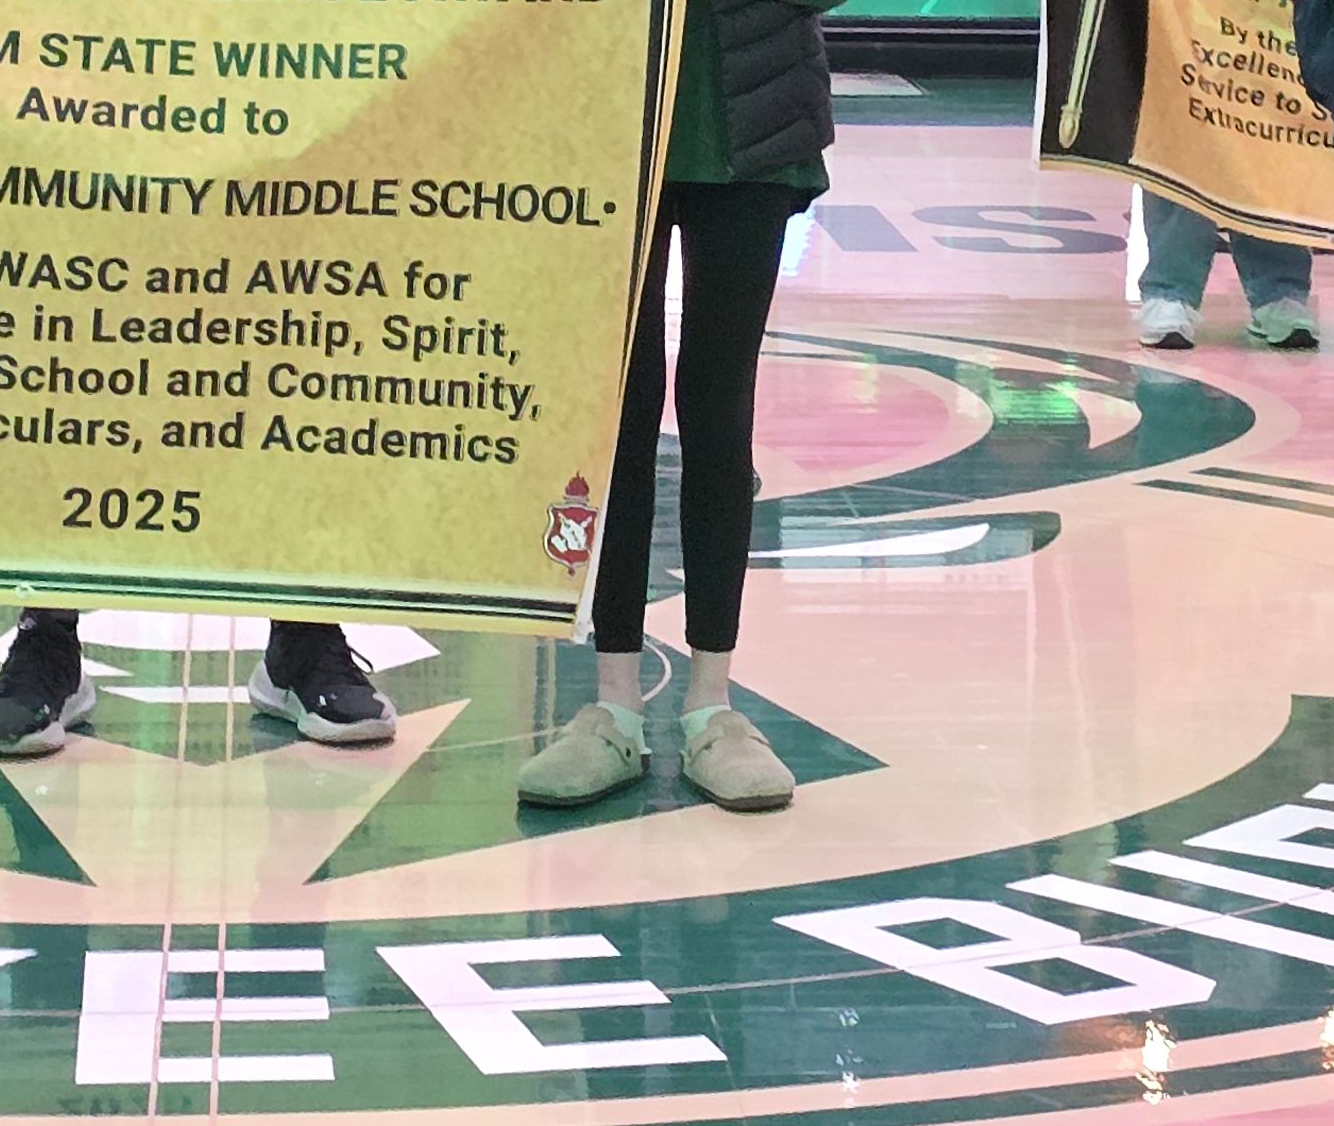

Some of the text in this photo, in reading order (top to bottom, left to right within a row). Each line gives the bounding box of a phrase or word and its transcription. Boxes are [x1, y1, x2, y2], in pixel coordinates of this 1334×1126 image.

[39, 32, 197, 78] STATE
[212, 40, 408, 80] WINNER
[1219, 15, 1298, 57] By the
[16, 86, 289, 136] Awarded to
[1276, 90, 1302, 116] to
[224, 178, 402, 218] MIDDLE
[145, 257, 230, 295] and
[245, 258, 388, 298] AWSA
[404, 260, 472, 301] for
[33, 304, 74, 342] in
[91, 307, 365, 357] Leadership,
[381, 314, 521, 365] Spirit,
[166, 360, 251, 398] and
[267, 361, 542, 421] Community,
[160, 412, 245, 450] and
[260, 414, 520, 465] Academics
[61, 487, 202, 534] 2025
